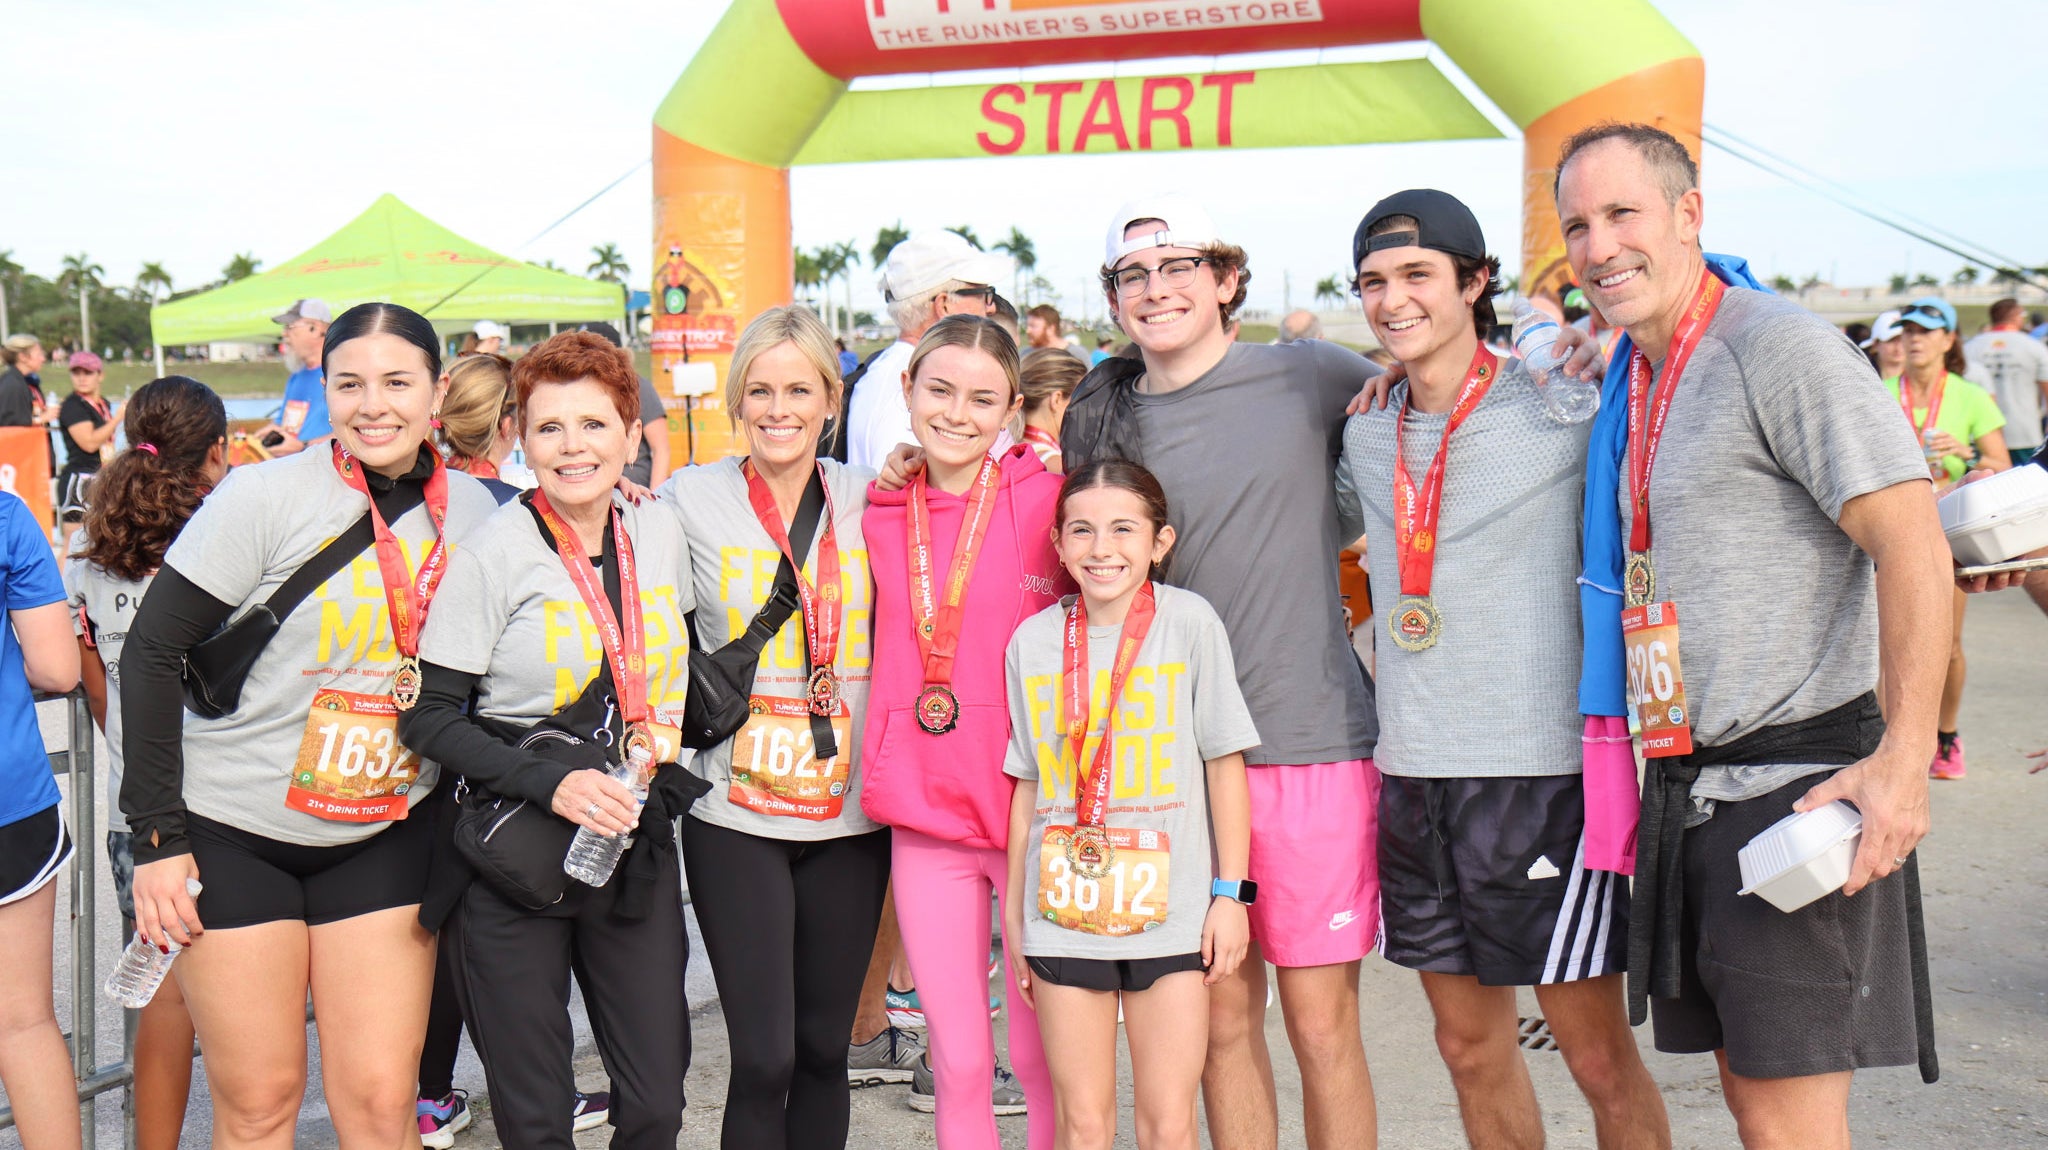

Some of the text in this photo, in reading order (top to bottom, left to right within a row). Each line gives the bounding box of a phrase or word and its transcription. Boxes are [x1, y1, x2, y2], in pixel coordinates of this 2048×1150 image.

[879, 1, 1312, 45] THE RUNNER'S SUPERSTORE
[976, 72, 1254, 154] START
[1653, 398, 1667, 434] TROT
[979, 459, 994, 487] TROT
[1405, 484, 1416, 516] TROT
[620, 551, 631, 582] TROT
[918, 544, 935, 618] TURKEY TROT
[419, 569, 434, 599] TROT
[544, 584, 687, 663] FEST
[803, 586, 817, 630] TURKEY
[606, 622, 625, 657] TROT
[1068, 619, 1076, 649] TROT
[1627, 640, 1674, 706] 626
[354, 701, 383, 709] TURKEY
[774, 703, 803, 712] TURKEY
[317, 722, 409, 779] 1632
[1648, 738, 1674, 749] TICKET
[1097, 767, 1109, 798] TROT
[307, 798, 390, 816] 21+ DRINK TICKET
[747, 797, 829, 814] 21+ DRINK TICKET
[1046, 856, 1158, 916] 3612
[1332, 909, 1353, 924] NIKE
[886, 993, 910, 1009] HOKA
